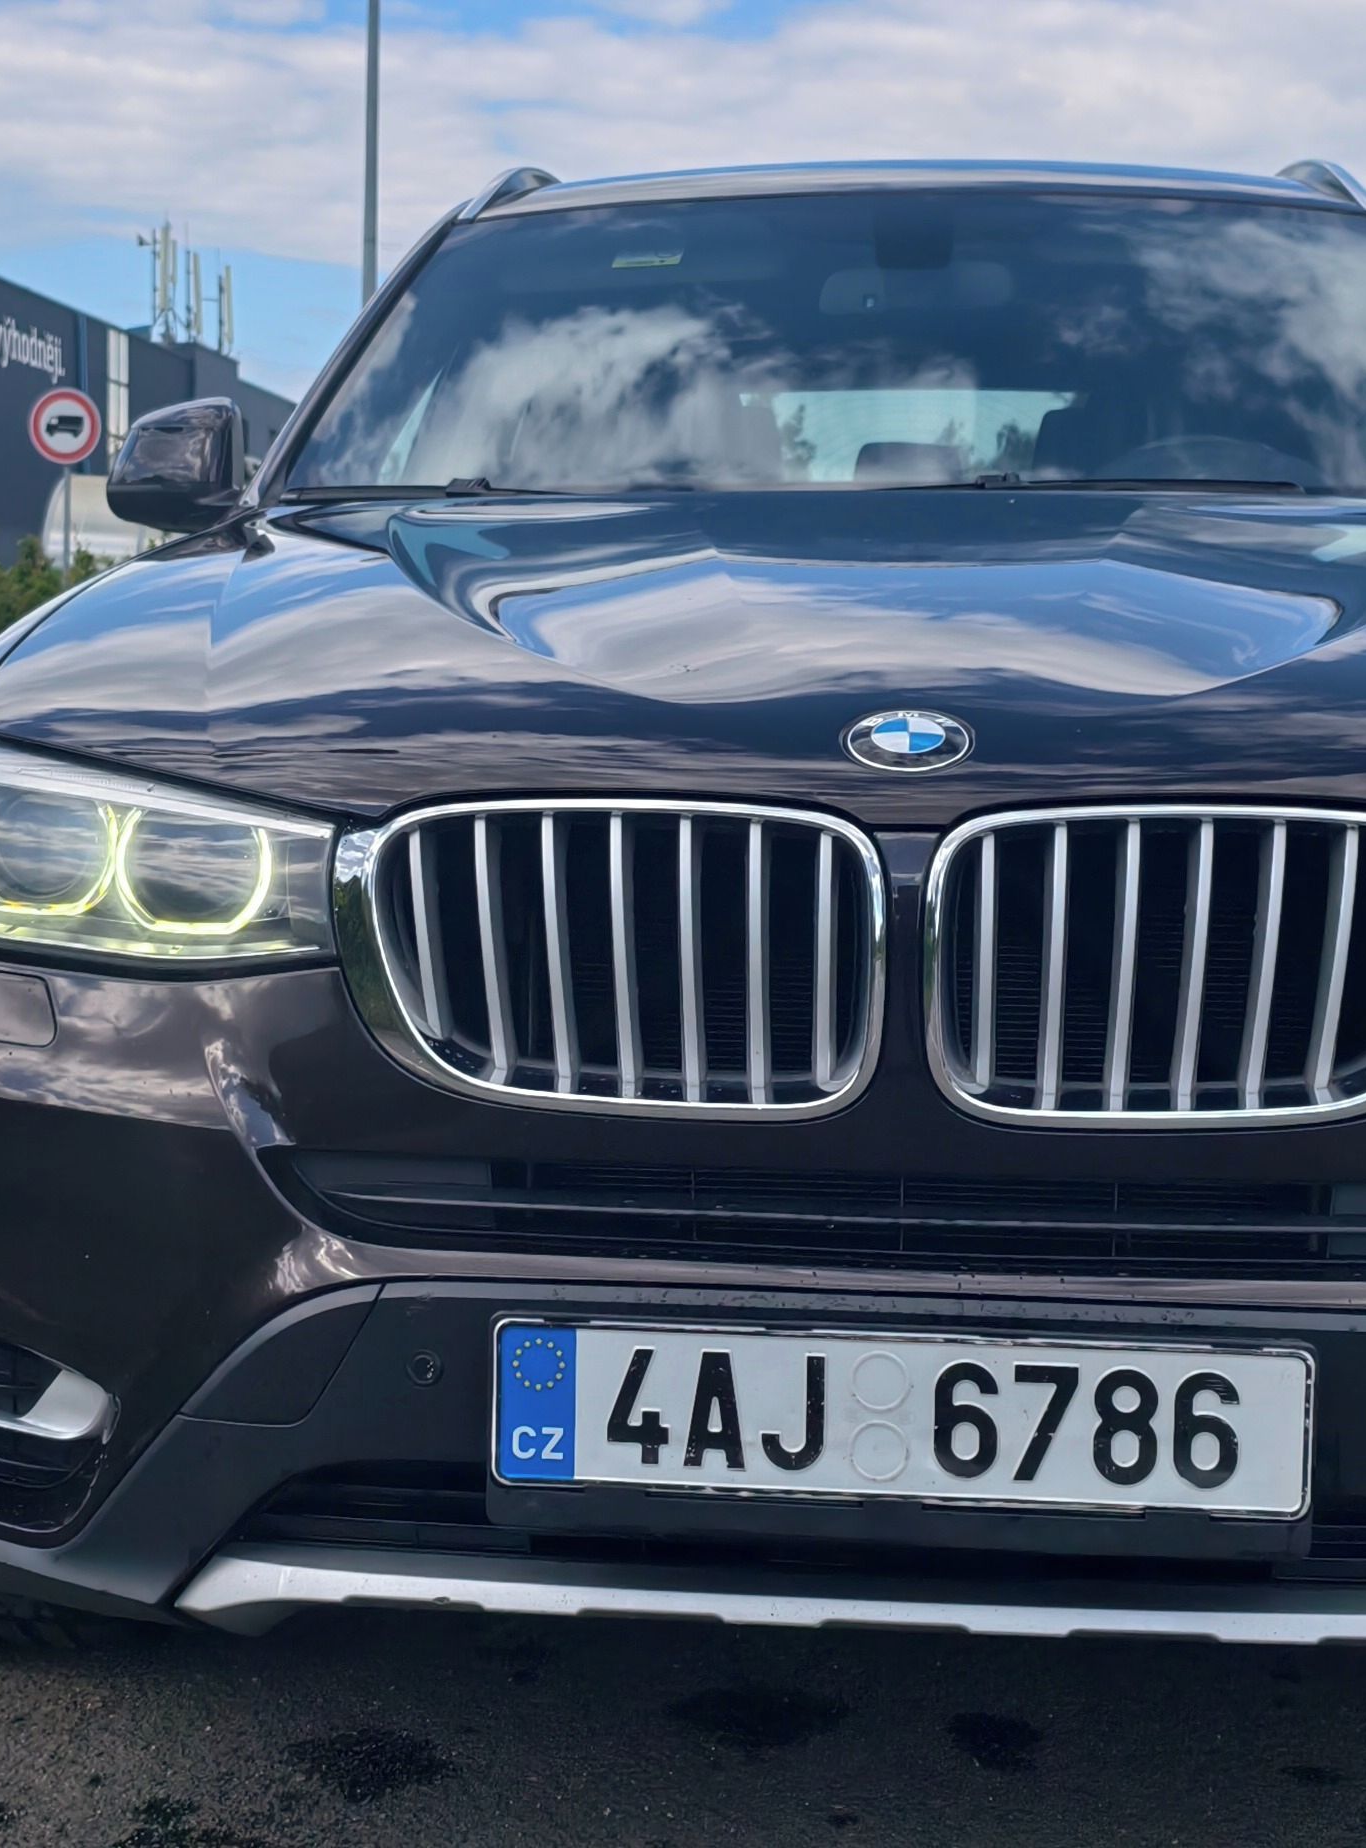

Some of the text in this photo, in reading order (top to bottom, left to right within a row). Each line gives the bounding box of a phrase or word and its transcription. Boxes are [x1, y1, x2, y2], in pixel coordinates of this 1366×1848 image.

[511, 1347, 1241, 1490] CZ 4AJ 6786
